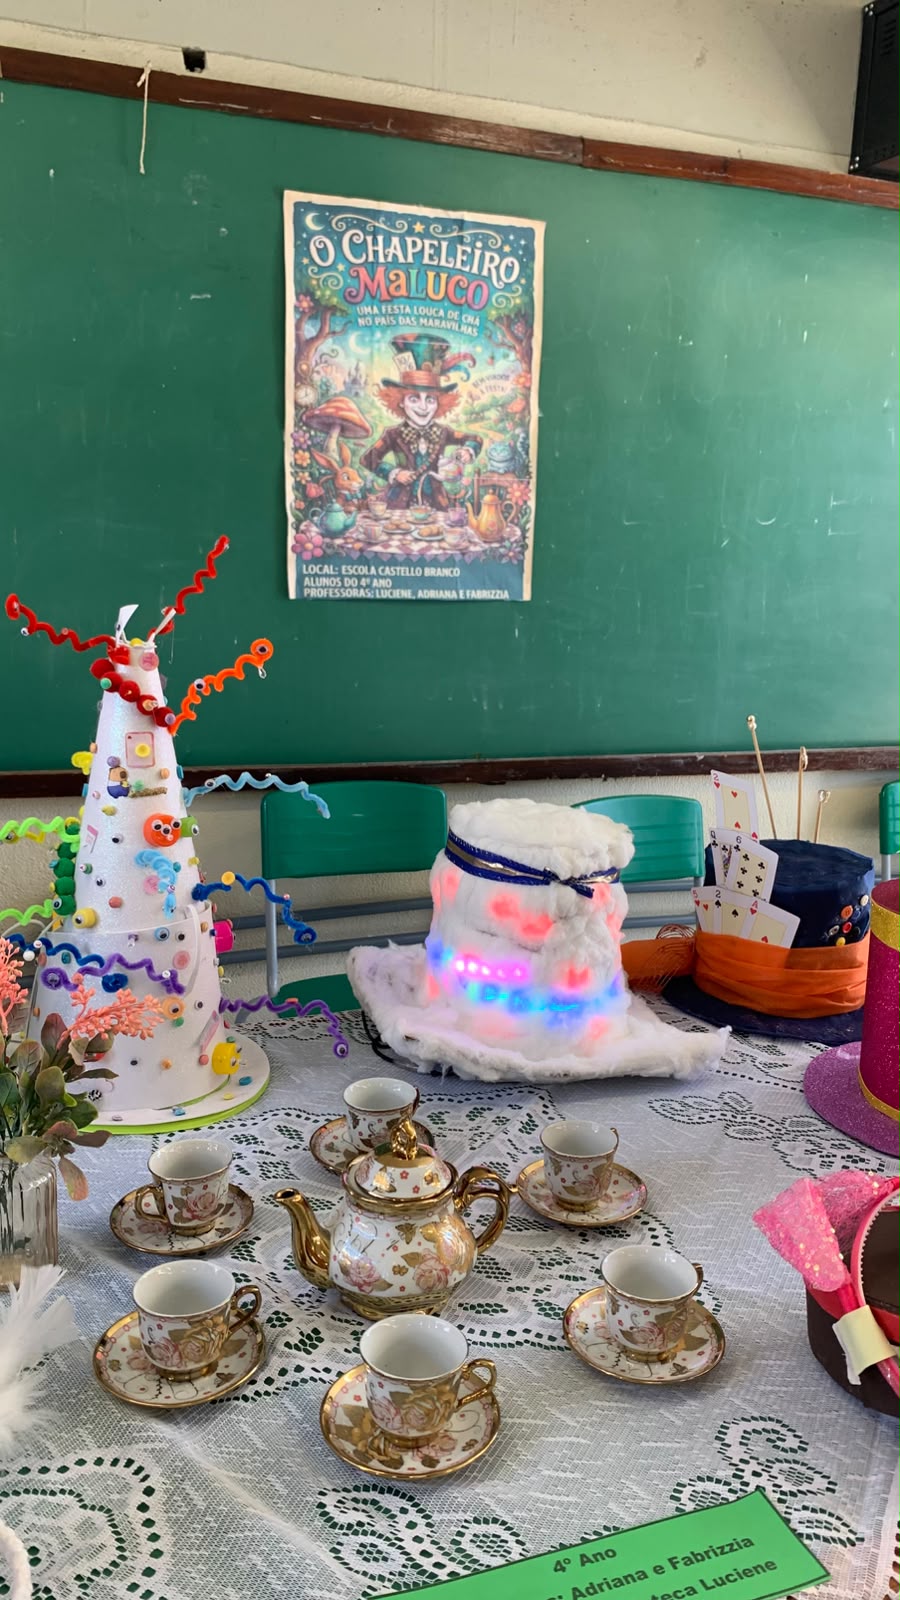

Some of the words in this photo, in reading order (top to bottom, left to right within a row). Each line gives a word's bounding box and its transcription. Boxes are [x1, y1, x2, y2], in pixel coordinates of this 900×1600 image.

[309, 235, 335, 267] O
[357, 305, 379, 315] UMA
[382, 305, 411, 315] FESTA
[414, 306, 444, 318] LOUCA
[447, 310, 459, 320] DE
[358, 317, 372, 327] NO
[398, 316, 416, 326] DAS
[419, 318, 478, 337] MARAVILHAS
[303, 564, 339, 575] LOCAL:
[341, 565, 376, 575] ESCOLA
[378, 566, 422, 576] CASTELLO
[424, 567, 460, 577] BRANCO
[304, 577, 342, 587] ALUNOS
[344, 577, 358, 587] DO
[373, 578, 392, 588] ANO
[304, 588, 374, 598] PROFESSORAS:
[376, 588, 415, 599] LUCIENE,
[417, 589, 457, 599] ADRIANA
[460, 589, 465, 599] E
[466, 589, 509, 599] FABRIZZIA
[713, 773, 719, 781] 2
[710, 830, 716, 839] Q
[736, 836, 742, 844] 6
[693, 890, 698, 898] 5
[715, 889, 721, 898] 2
[579, 1548, 617, 1568] Ano
[571, 1569, 649, 1600] Adriana
[653, 1563, 665, 1575] e
[667, 1537, 755, 1570] Fabrizzia
[699, 1559, 778, 1591] Luciene
